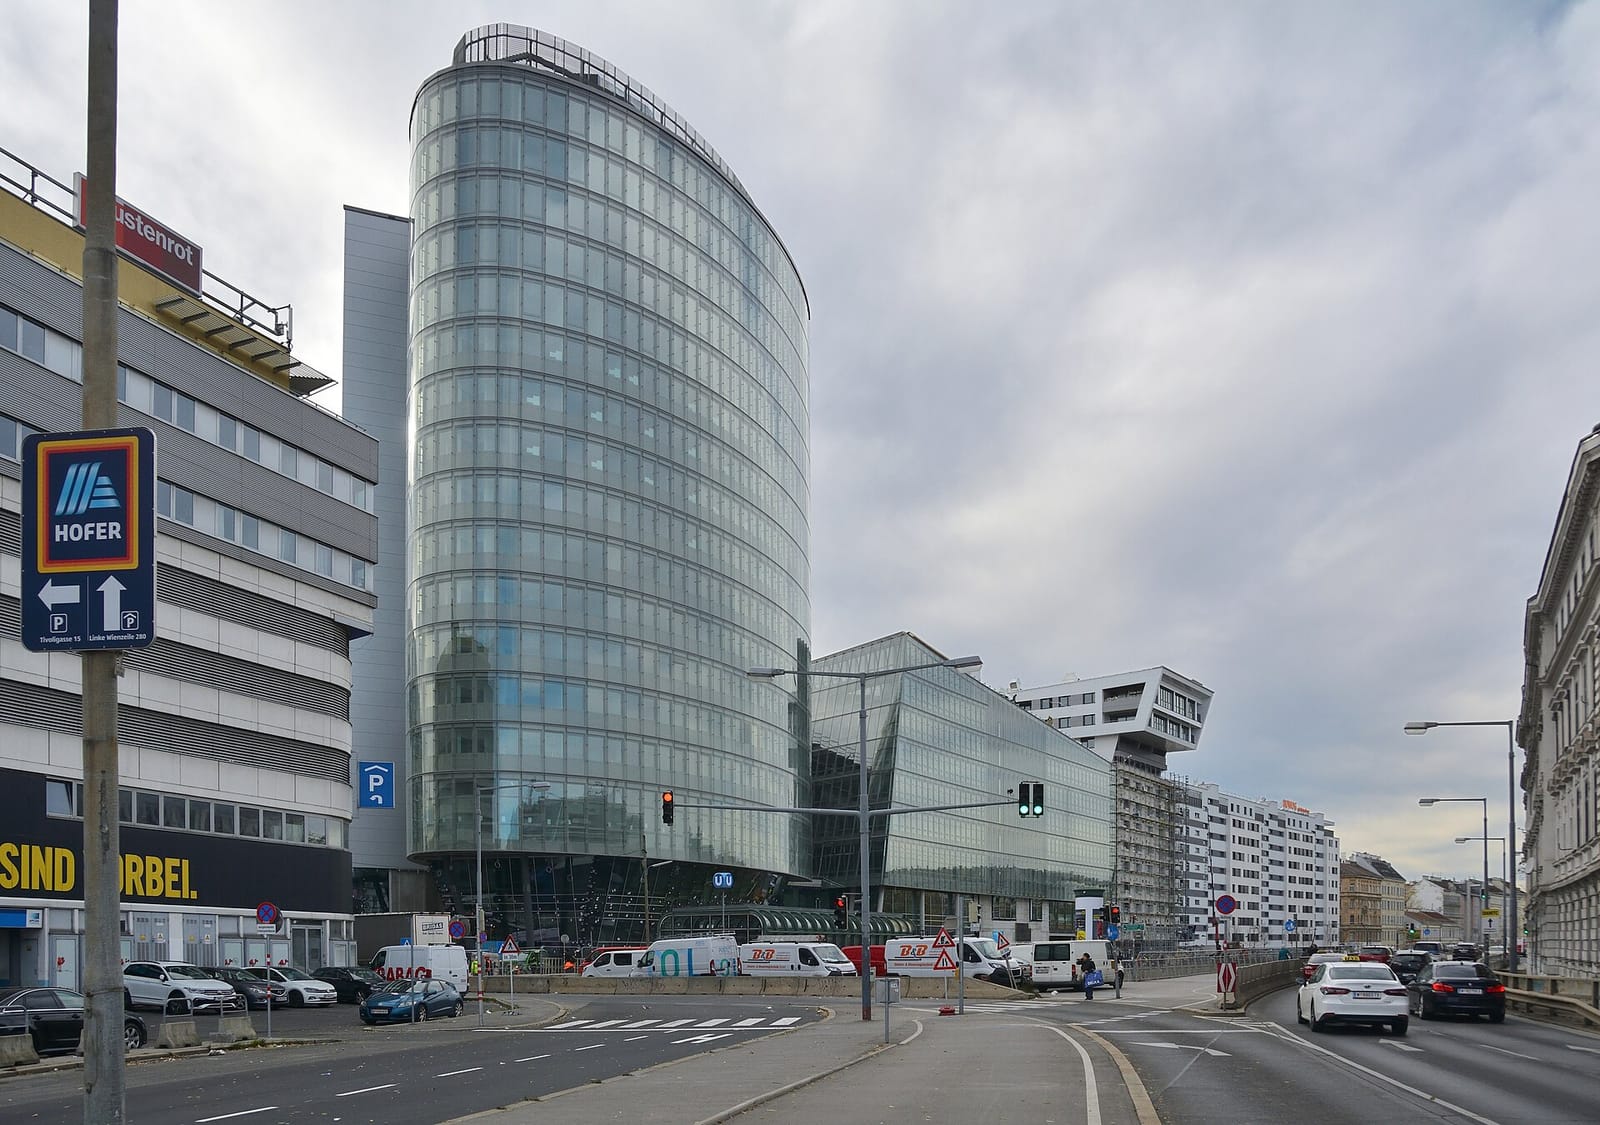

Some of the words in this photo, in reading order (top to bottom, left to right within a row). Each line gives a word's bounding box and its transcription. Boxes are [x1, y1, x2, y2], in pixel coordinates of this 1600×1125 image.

[55, 521, 122, 542] HOFER
[53, 617, 64, 631] P
[126, 617, 135, 628] P
[40, 636, 73, 644] Tivoligasse
[106, 633, 135, 641] Wienzeile
[369, 774, 384, 792] P
[0, 842, 76, 892] SIND
[119, 854, 198, 900] RBEI.
[900, 944, 929, 958] B&B
